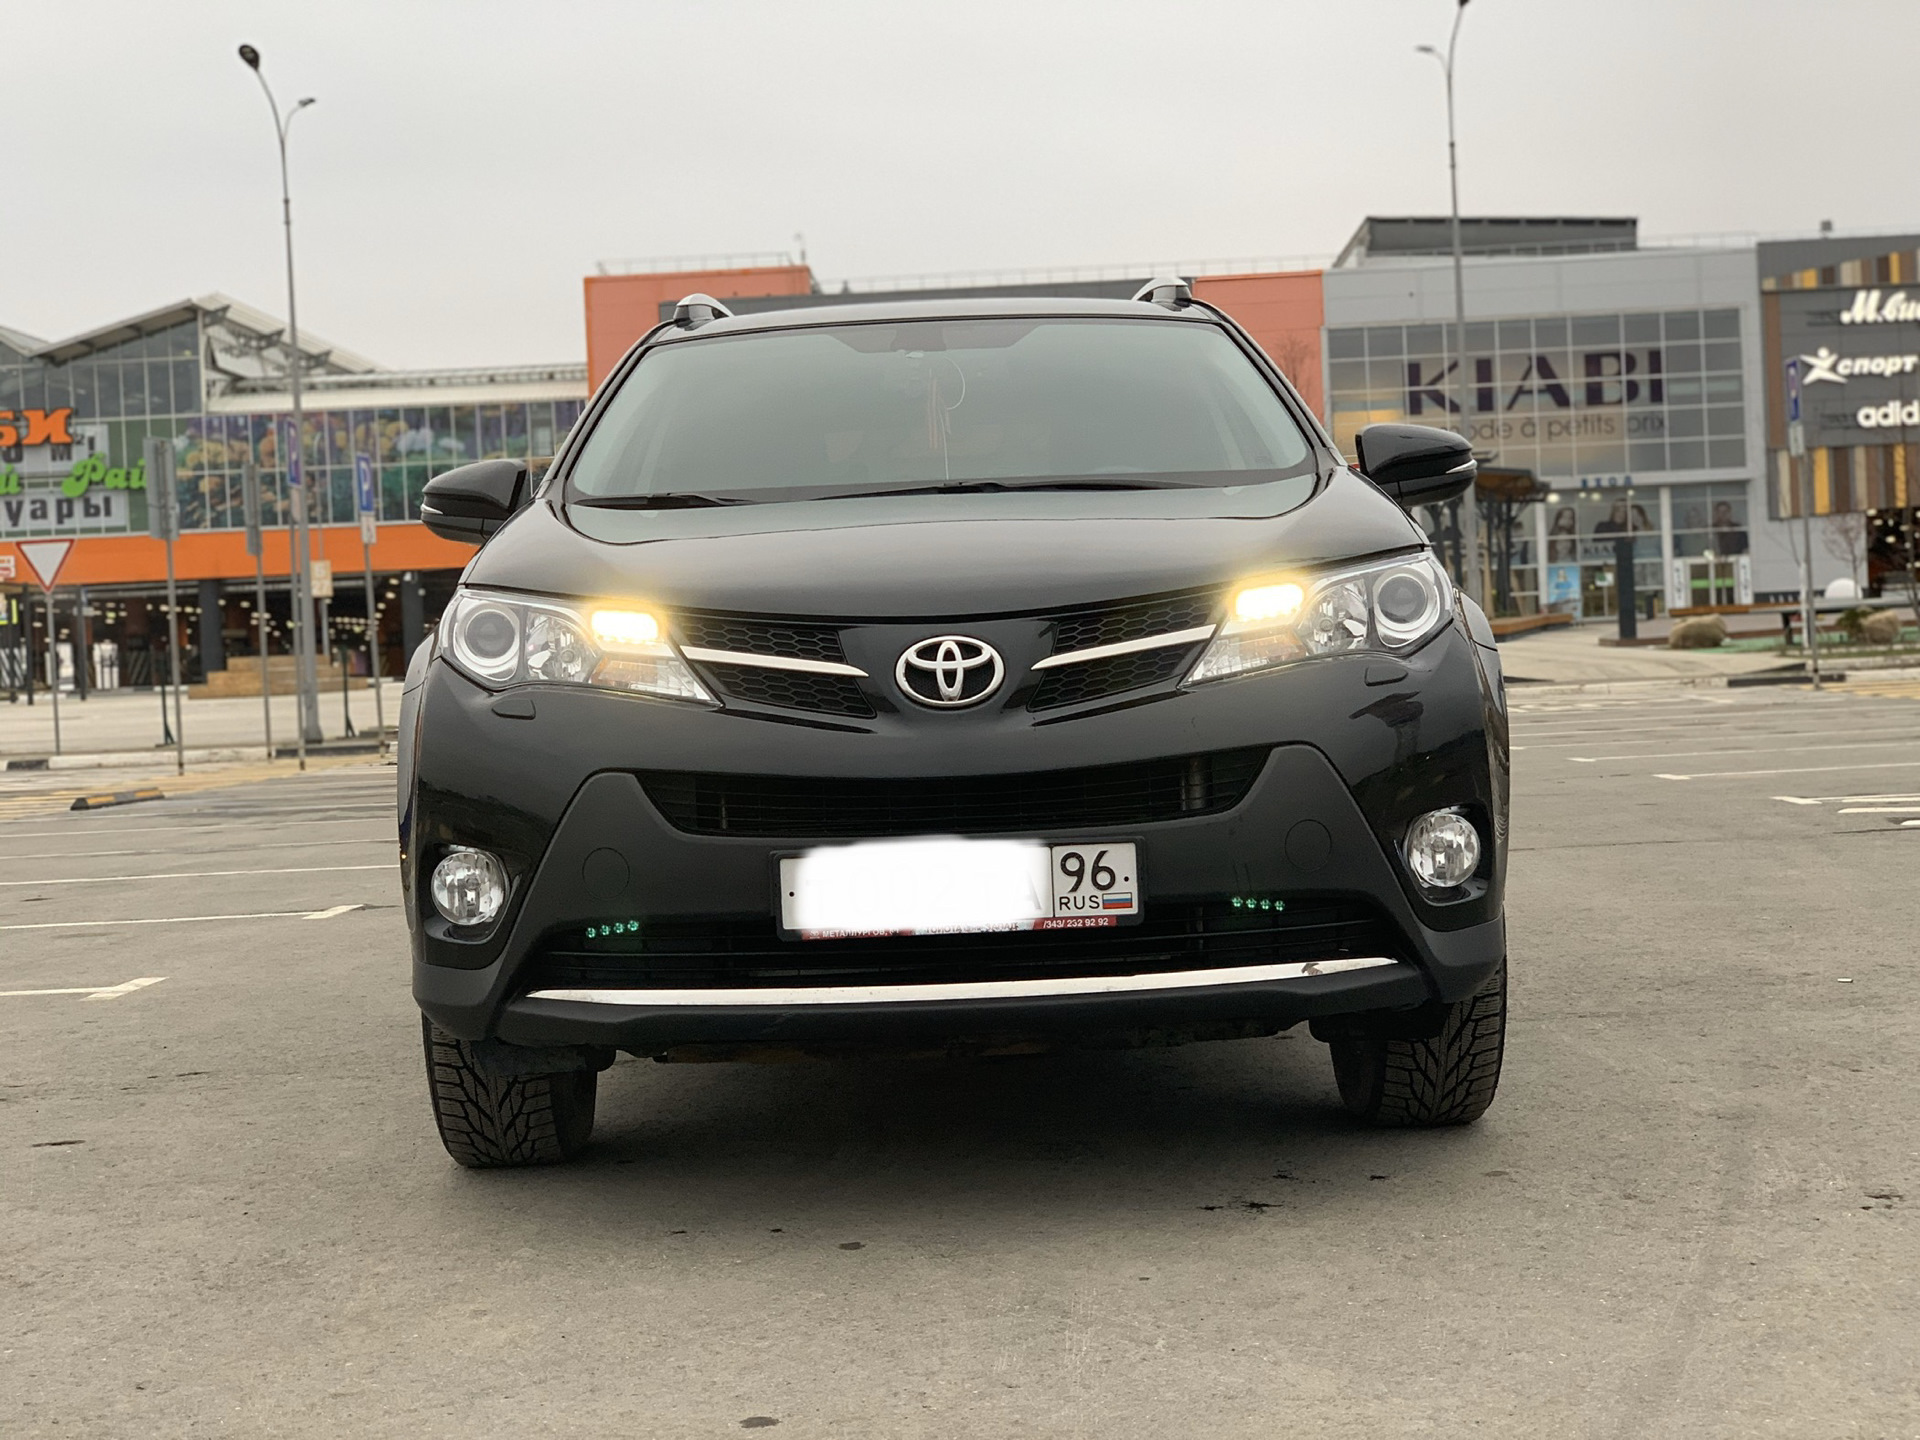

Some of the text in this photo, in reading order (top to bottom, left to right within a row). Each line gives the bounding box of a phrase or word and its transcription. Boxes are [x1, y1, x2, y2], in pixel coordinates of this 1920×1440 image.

[1836, 355, 1918, 377] спорт
[1407, 350, 1664, 415] KIABI
[1547, 412, 1615, 442] petits
[1060, 850, 1116, 893] 96
[1059, 895, 1100, 910] RUS
[1084, 917, 1096, 927] 92
[1097, 916, 1109, 926] 92
